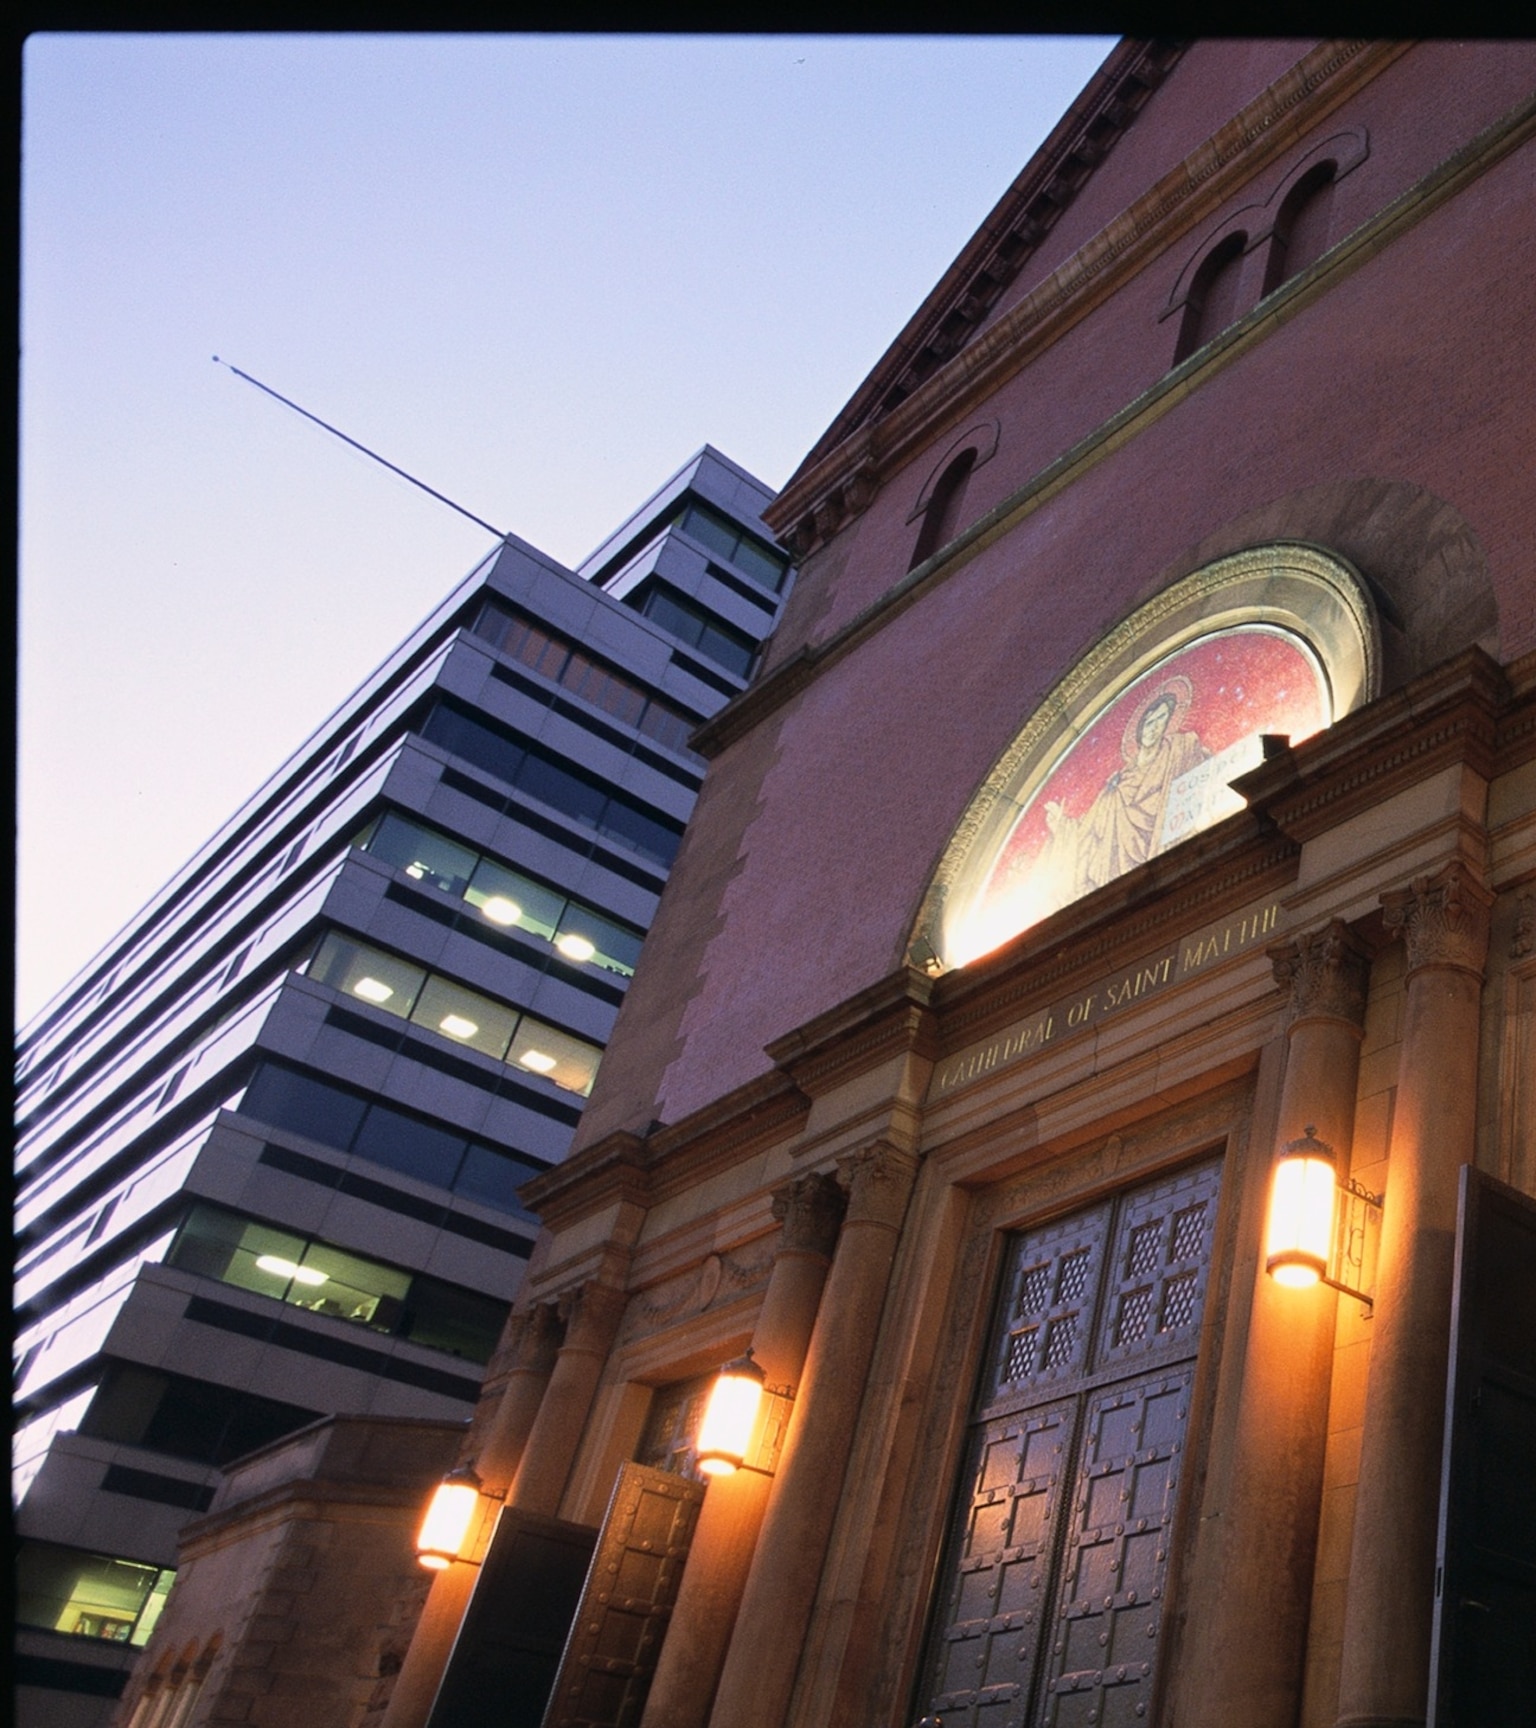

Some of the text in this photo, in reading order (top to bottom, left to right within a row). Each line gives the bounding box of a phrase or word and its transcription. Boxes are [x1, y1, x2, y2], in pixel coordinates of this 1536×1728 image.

[941, 1017, 1056, 1089] CATHEDRAL
[1068, 994, 1098, 1028] OF
[1103, 955, 1175, 1011] SAINT
